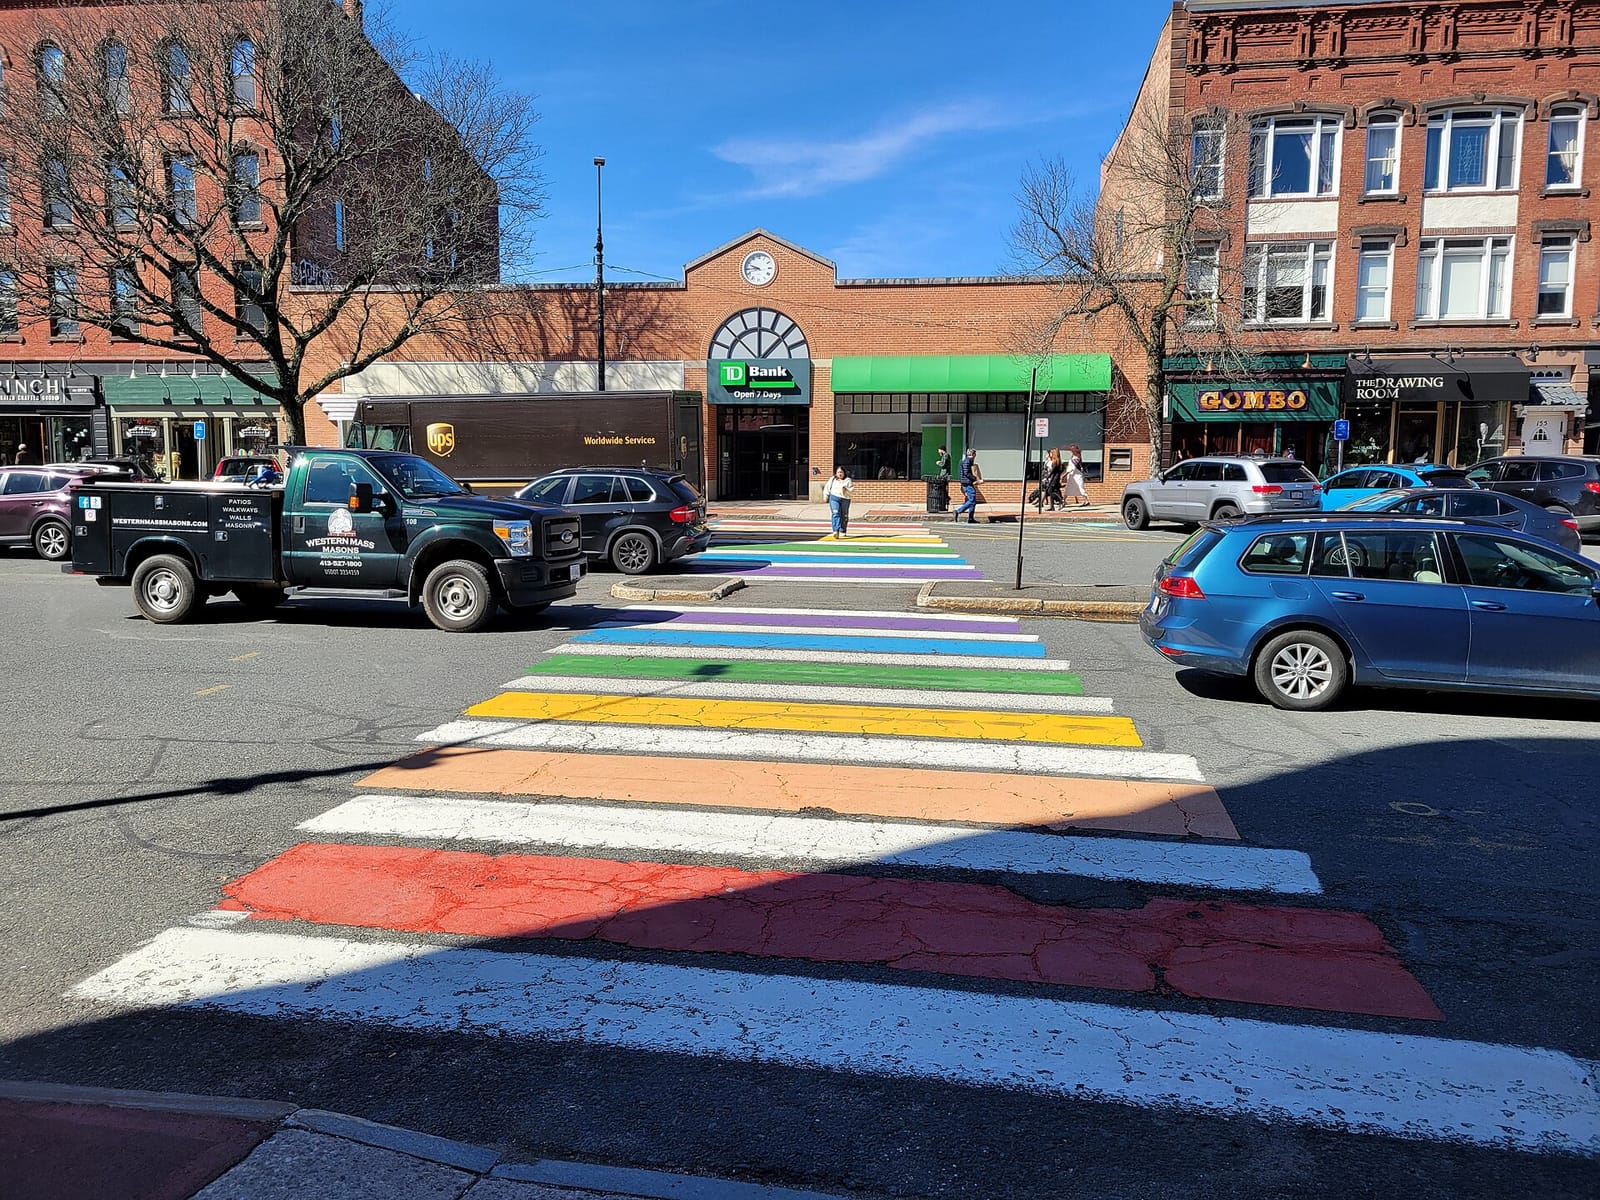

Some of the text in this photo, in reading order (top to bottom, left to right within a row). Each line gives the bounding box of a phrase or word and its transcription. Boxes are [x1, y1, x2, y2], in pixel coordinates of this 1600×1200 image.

[722, 366, 787, 381] TD Bank
[0, 379, 60, 394] INCH
[1356, 377, 1444, 388] THE DRAWING
[733, 391, 755, 400] Open
[763, 391, 782, 400] Days
[1356, 388, 1400, 399] ROOM
[1200, 390, 1307, 410] GOMBO
[429, 432, 453, 452] ups
[584, 436, 656, 446] Worldwide Services
[222, 506, 259, 514] WALKWAYS
[112, 518, 208, 527] WESTERNMASSMASONS.COM
[305, 537, 375, 549] WESTERN MASS
[322, 546, 360, 554] MASONS
